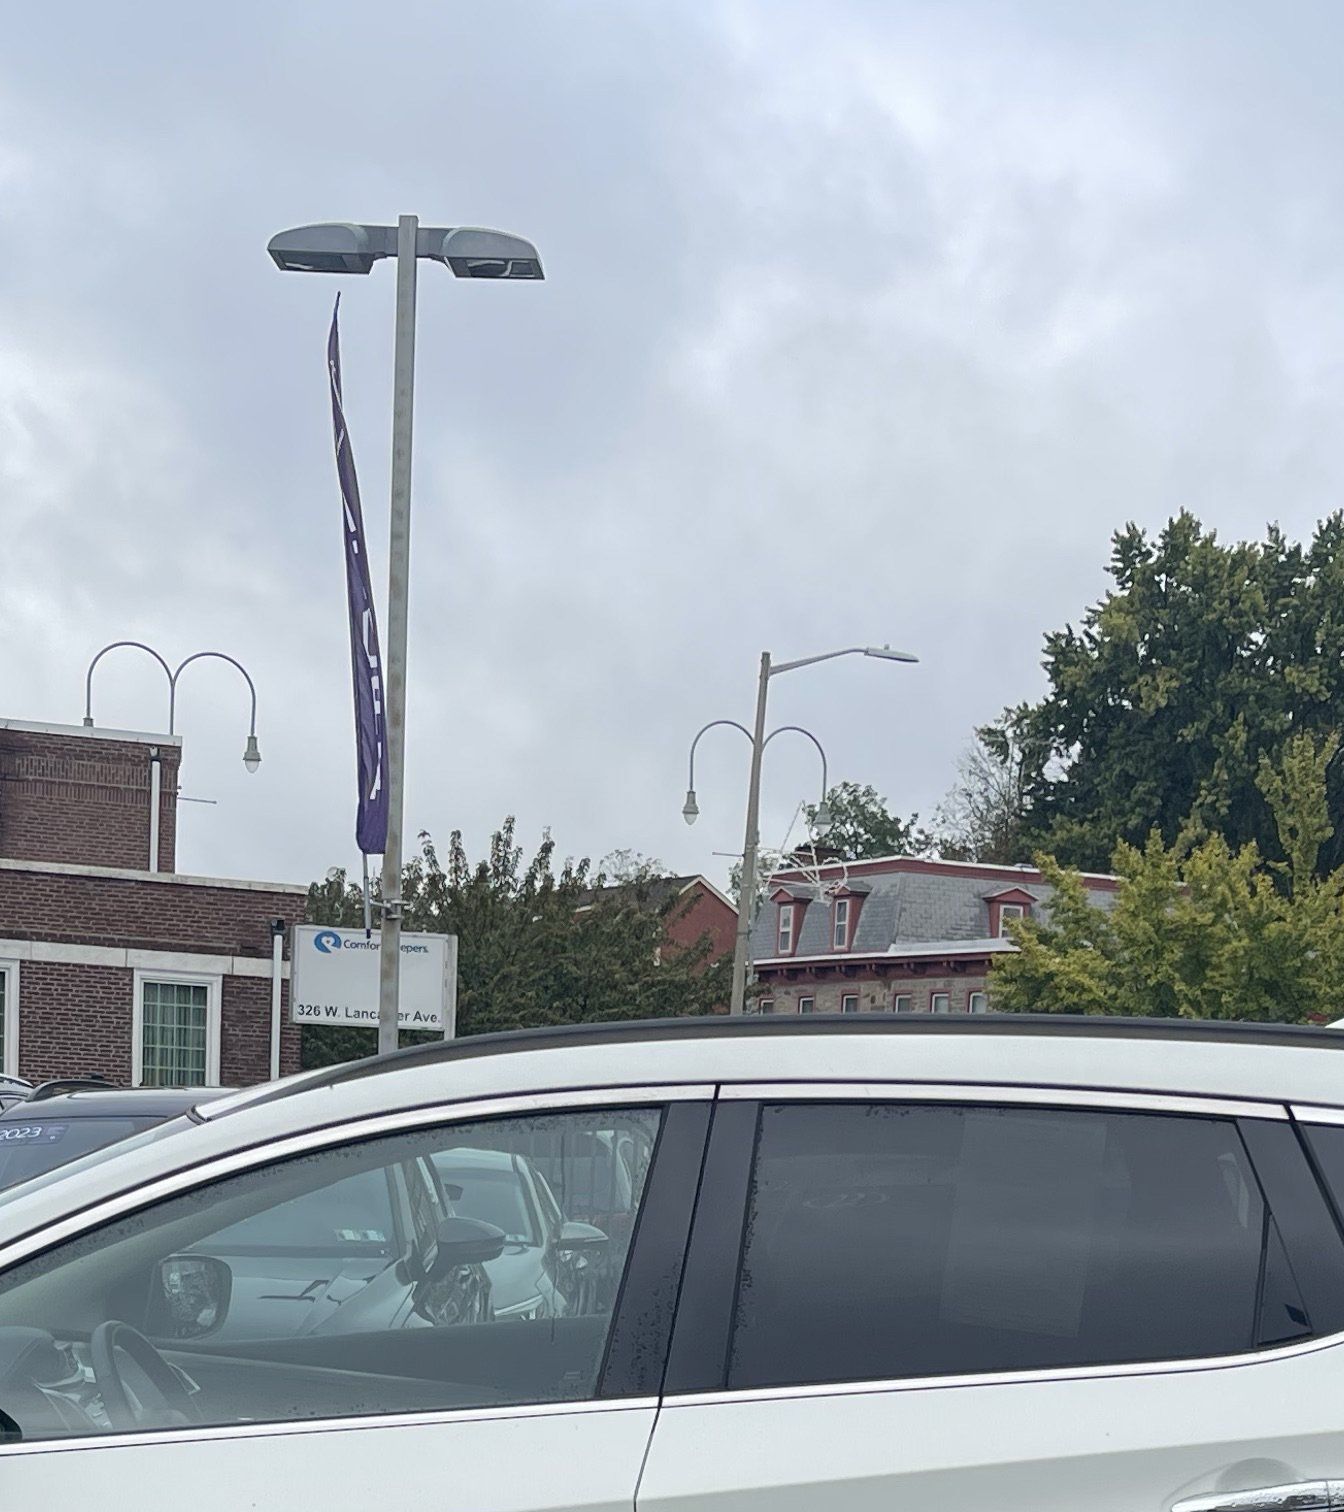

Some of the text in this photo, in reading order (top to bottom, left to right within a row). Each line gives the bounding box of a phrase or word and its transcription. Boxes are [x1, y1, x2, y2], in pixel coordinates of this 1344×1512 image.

[343, 938, 381, 951] Comfor
[297, 1004, 321, 1017] 326
[324, 1005, 341, 1018] W.
[413, 1010, 441, 1024] Ave.
